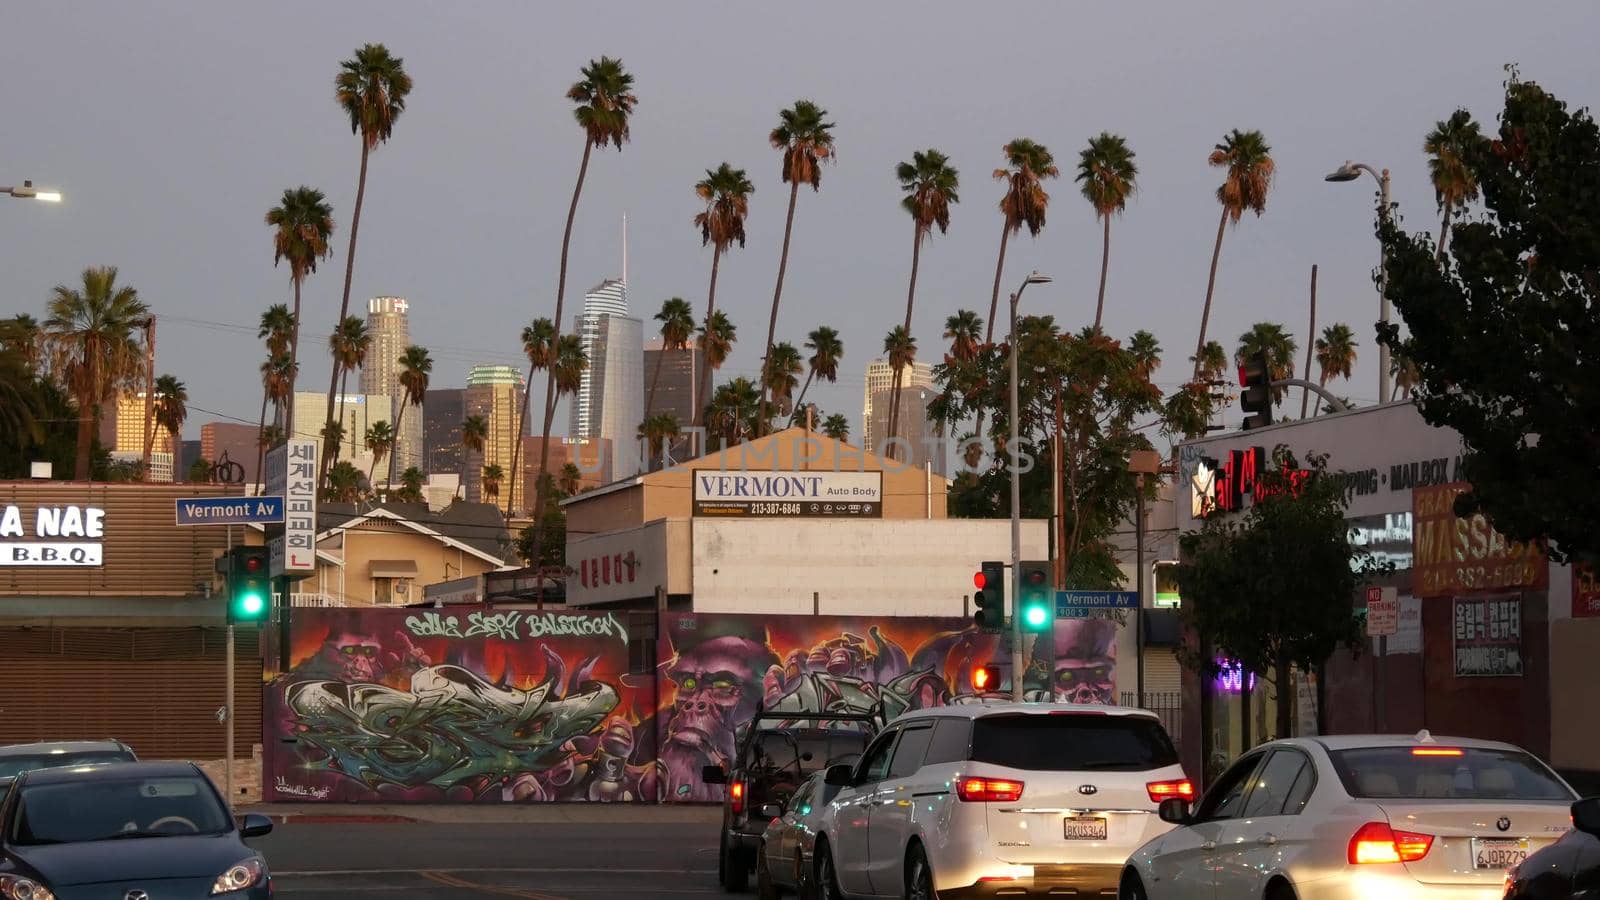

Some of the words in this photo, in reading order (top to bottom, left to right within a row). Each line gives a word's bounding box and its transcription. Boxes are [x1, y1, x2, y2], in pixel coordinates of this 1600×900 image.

[1391, 458, 1448, 489] MAILBOX
[701, 475, 823, 498] VERMONT
[826, 486, 850, 496] Auto
[852, 486, 877, 499] Body
[287, 445, 314, 550] 세계선교교회
[185, 502, 250, 518] Vermont
[256, 502, 275, 516] Av
[751, 503, 801, 515] 213-387-6846
[37, 505, 105, 538] NAE
[13, 547, 95, 563] B.B.Q.
[1065, 593, 1111, 605] Vermont
[1115, 593, 1129, 605] Av
[1370, 589, 1381, 601] NO
